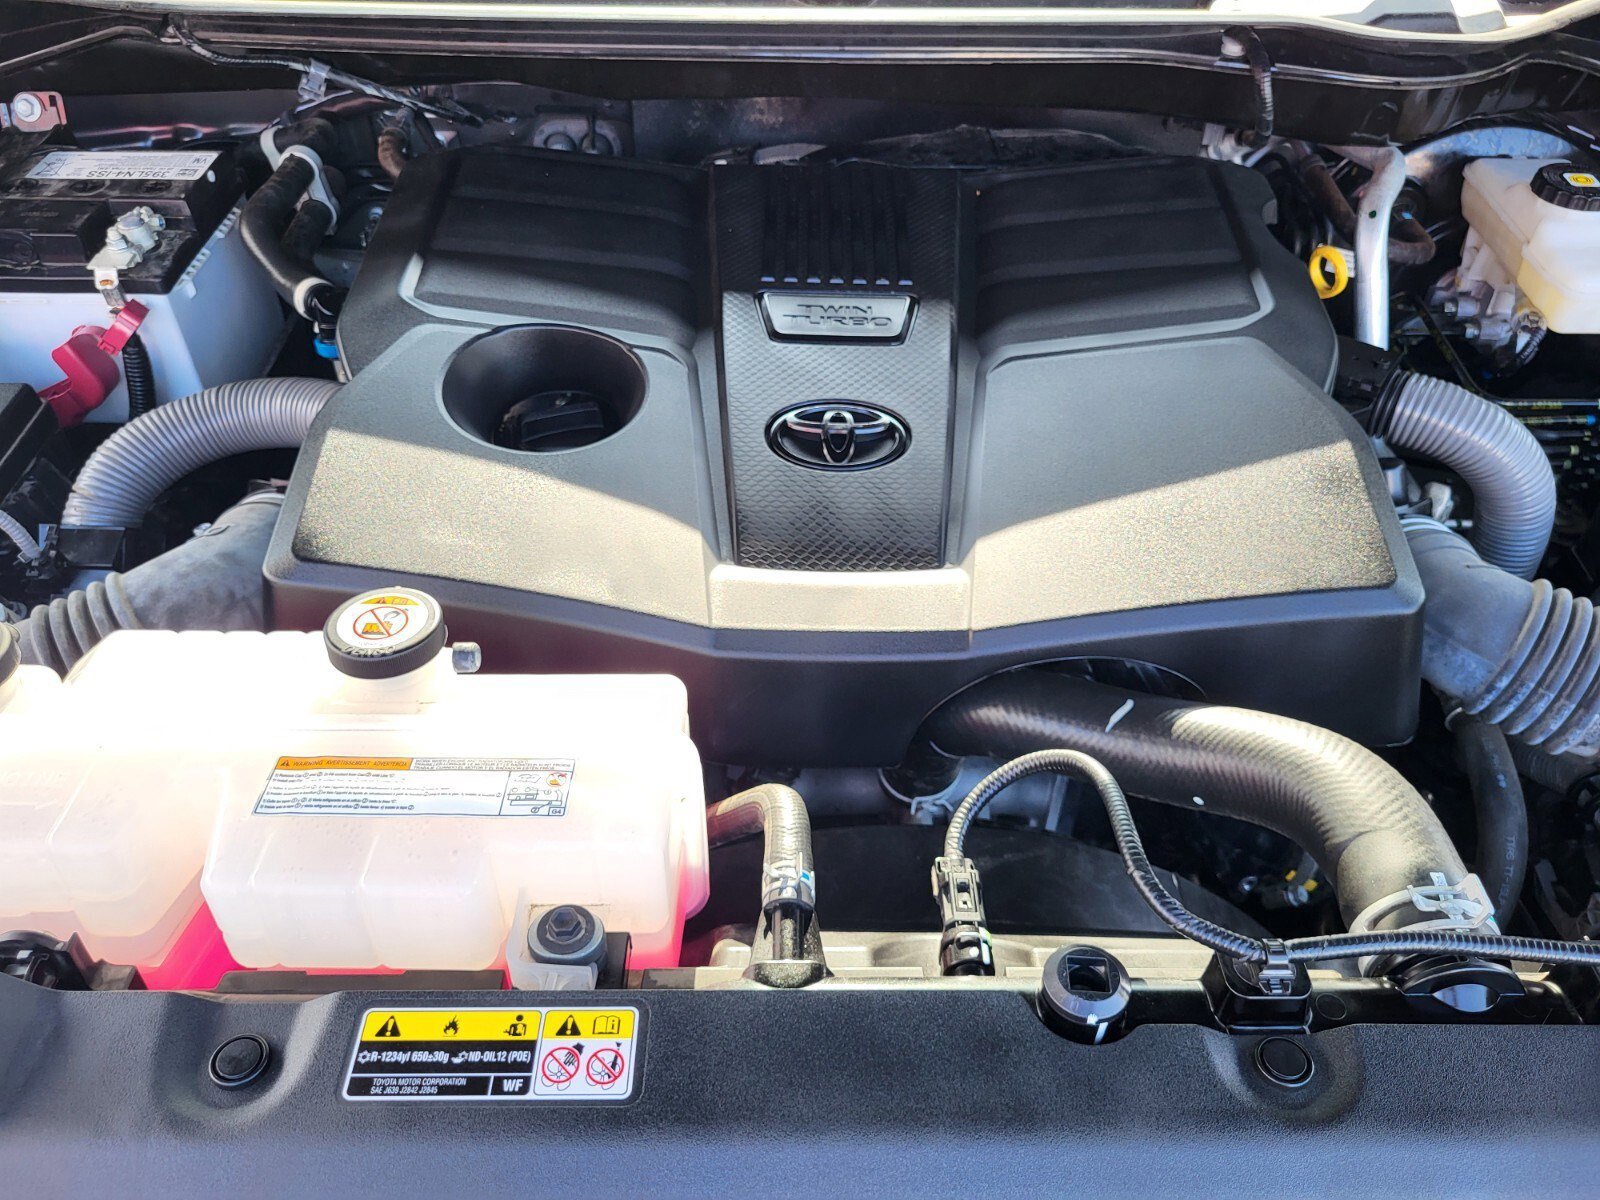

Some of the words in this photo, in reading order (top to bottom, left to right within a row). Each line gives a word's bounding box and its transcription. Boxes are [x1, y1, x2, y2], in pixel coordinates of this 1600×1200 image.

[797, 304, 873, 315] TWIN
[783, 314, 892, 327] TURBO
[370, 1051, 411, 1064] R-1234yf
[411, 1051, 450, 1064] 650±30g
[508, 1051, 532, 1064] (POE)
[373, 1077, 397, 1086] TOYOTA
[398, 1077, 421, 1086] MOTOR
[422, 1077, 467, 1086] CORPORATION
[503, 1079, 524, 1092] WF
[370, 1086, 383, 1094] SAE
[384, 1086, 399, 1094] J639
[400, 1086, 418, 1094] J2842
[419, 1086, 438, 1094] J2845
